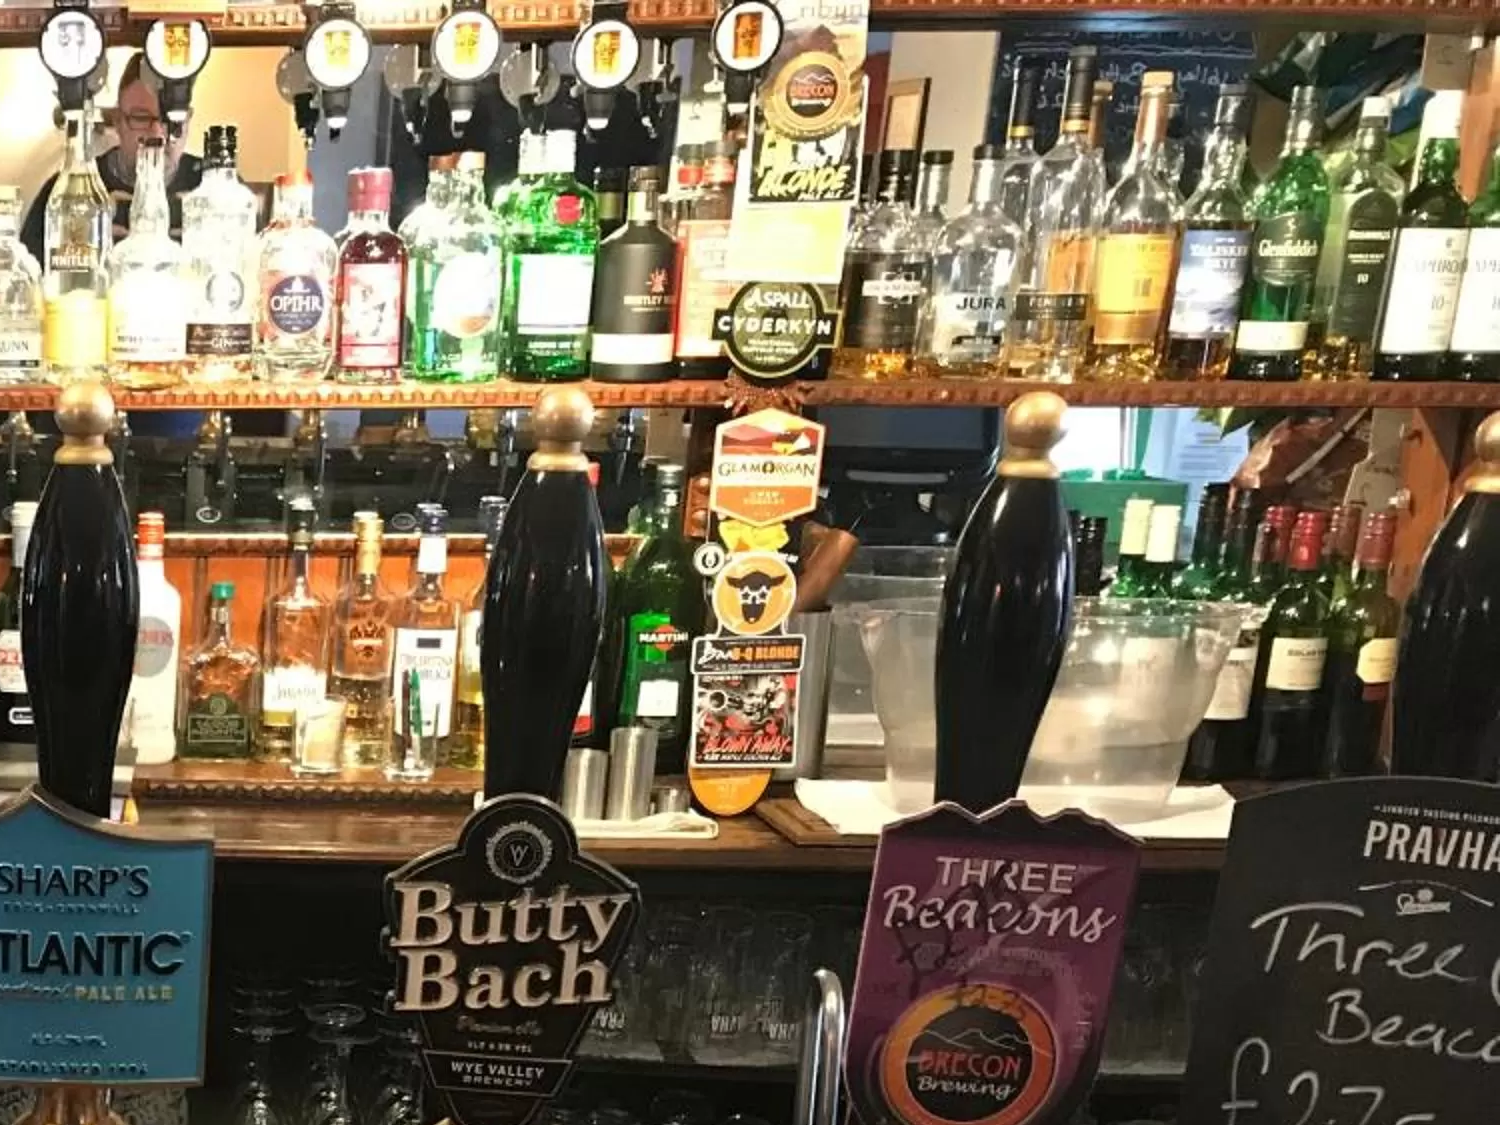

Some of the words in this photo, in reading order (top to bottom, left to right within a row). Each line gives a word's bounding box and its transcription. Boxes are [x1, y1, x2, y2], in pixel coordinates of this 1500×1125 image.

[270, 294, 324, 313] OPIHR
[744, 287, 810, 312] ASPALL
[956, 296, 1007, 311] JURA
[717, 315, 832, 337] CYDERKYN
[718, 461, 817, 478] GLAMORGAN
[638, 632, 689, 644] MARTINI
[936, 856, 1078, 894] THREE
[391, 881, 632, 953] Butty
[883, 885, 1116, 943] Beacons
[1249, 902, 1477, 982] Three
[394, 939, 612, 1011] Bach
[74, 985, 126, 1002] PALE
[135, 985, 176, 1001] ALE
[450, 1061, 483, 1075] WYE
[488, 1064, 545, 1079] VALLEY
[916, 1051, 1021, 1080] BRECON
[916, 1077, 1018, 1100] Brewing
